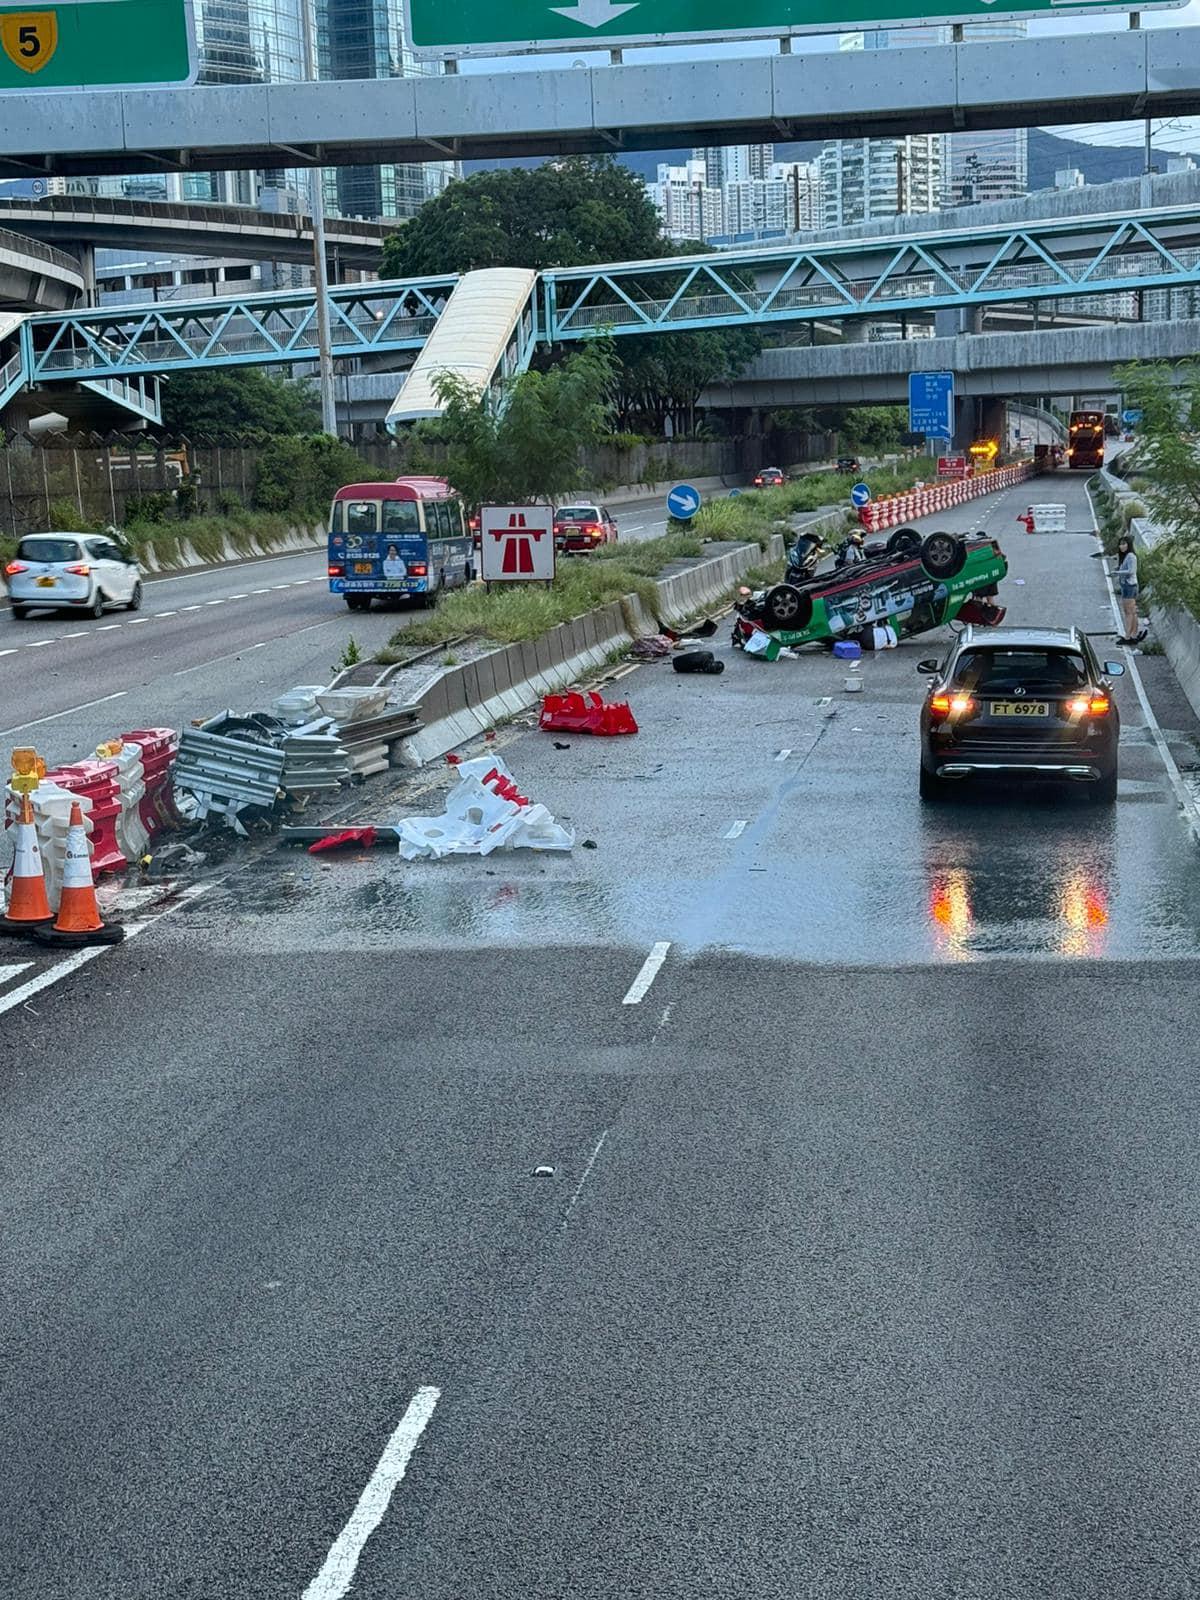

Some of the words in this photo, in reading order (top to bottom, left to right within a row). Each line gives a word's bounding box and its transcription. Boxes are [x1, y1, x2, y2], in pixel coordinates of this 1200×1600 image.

[19, 26, 41, 57] 5
[993, 704, 1010, 715] FT
[1014, 704, 1046, 715] 6978
